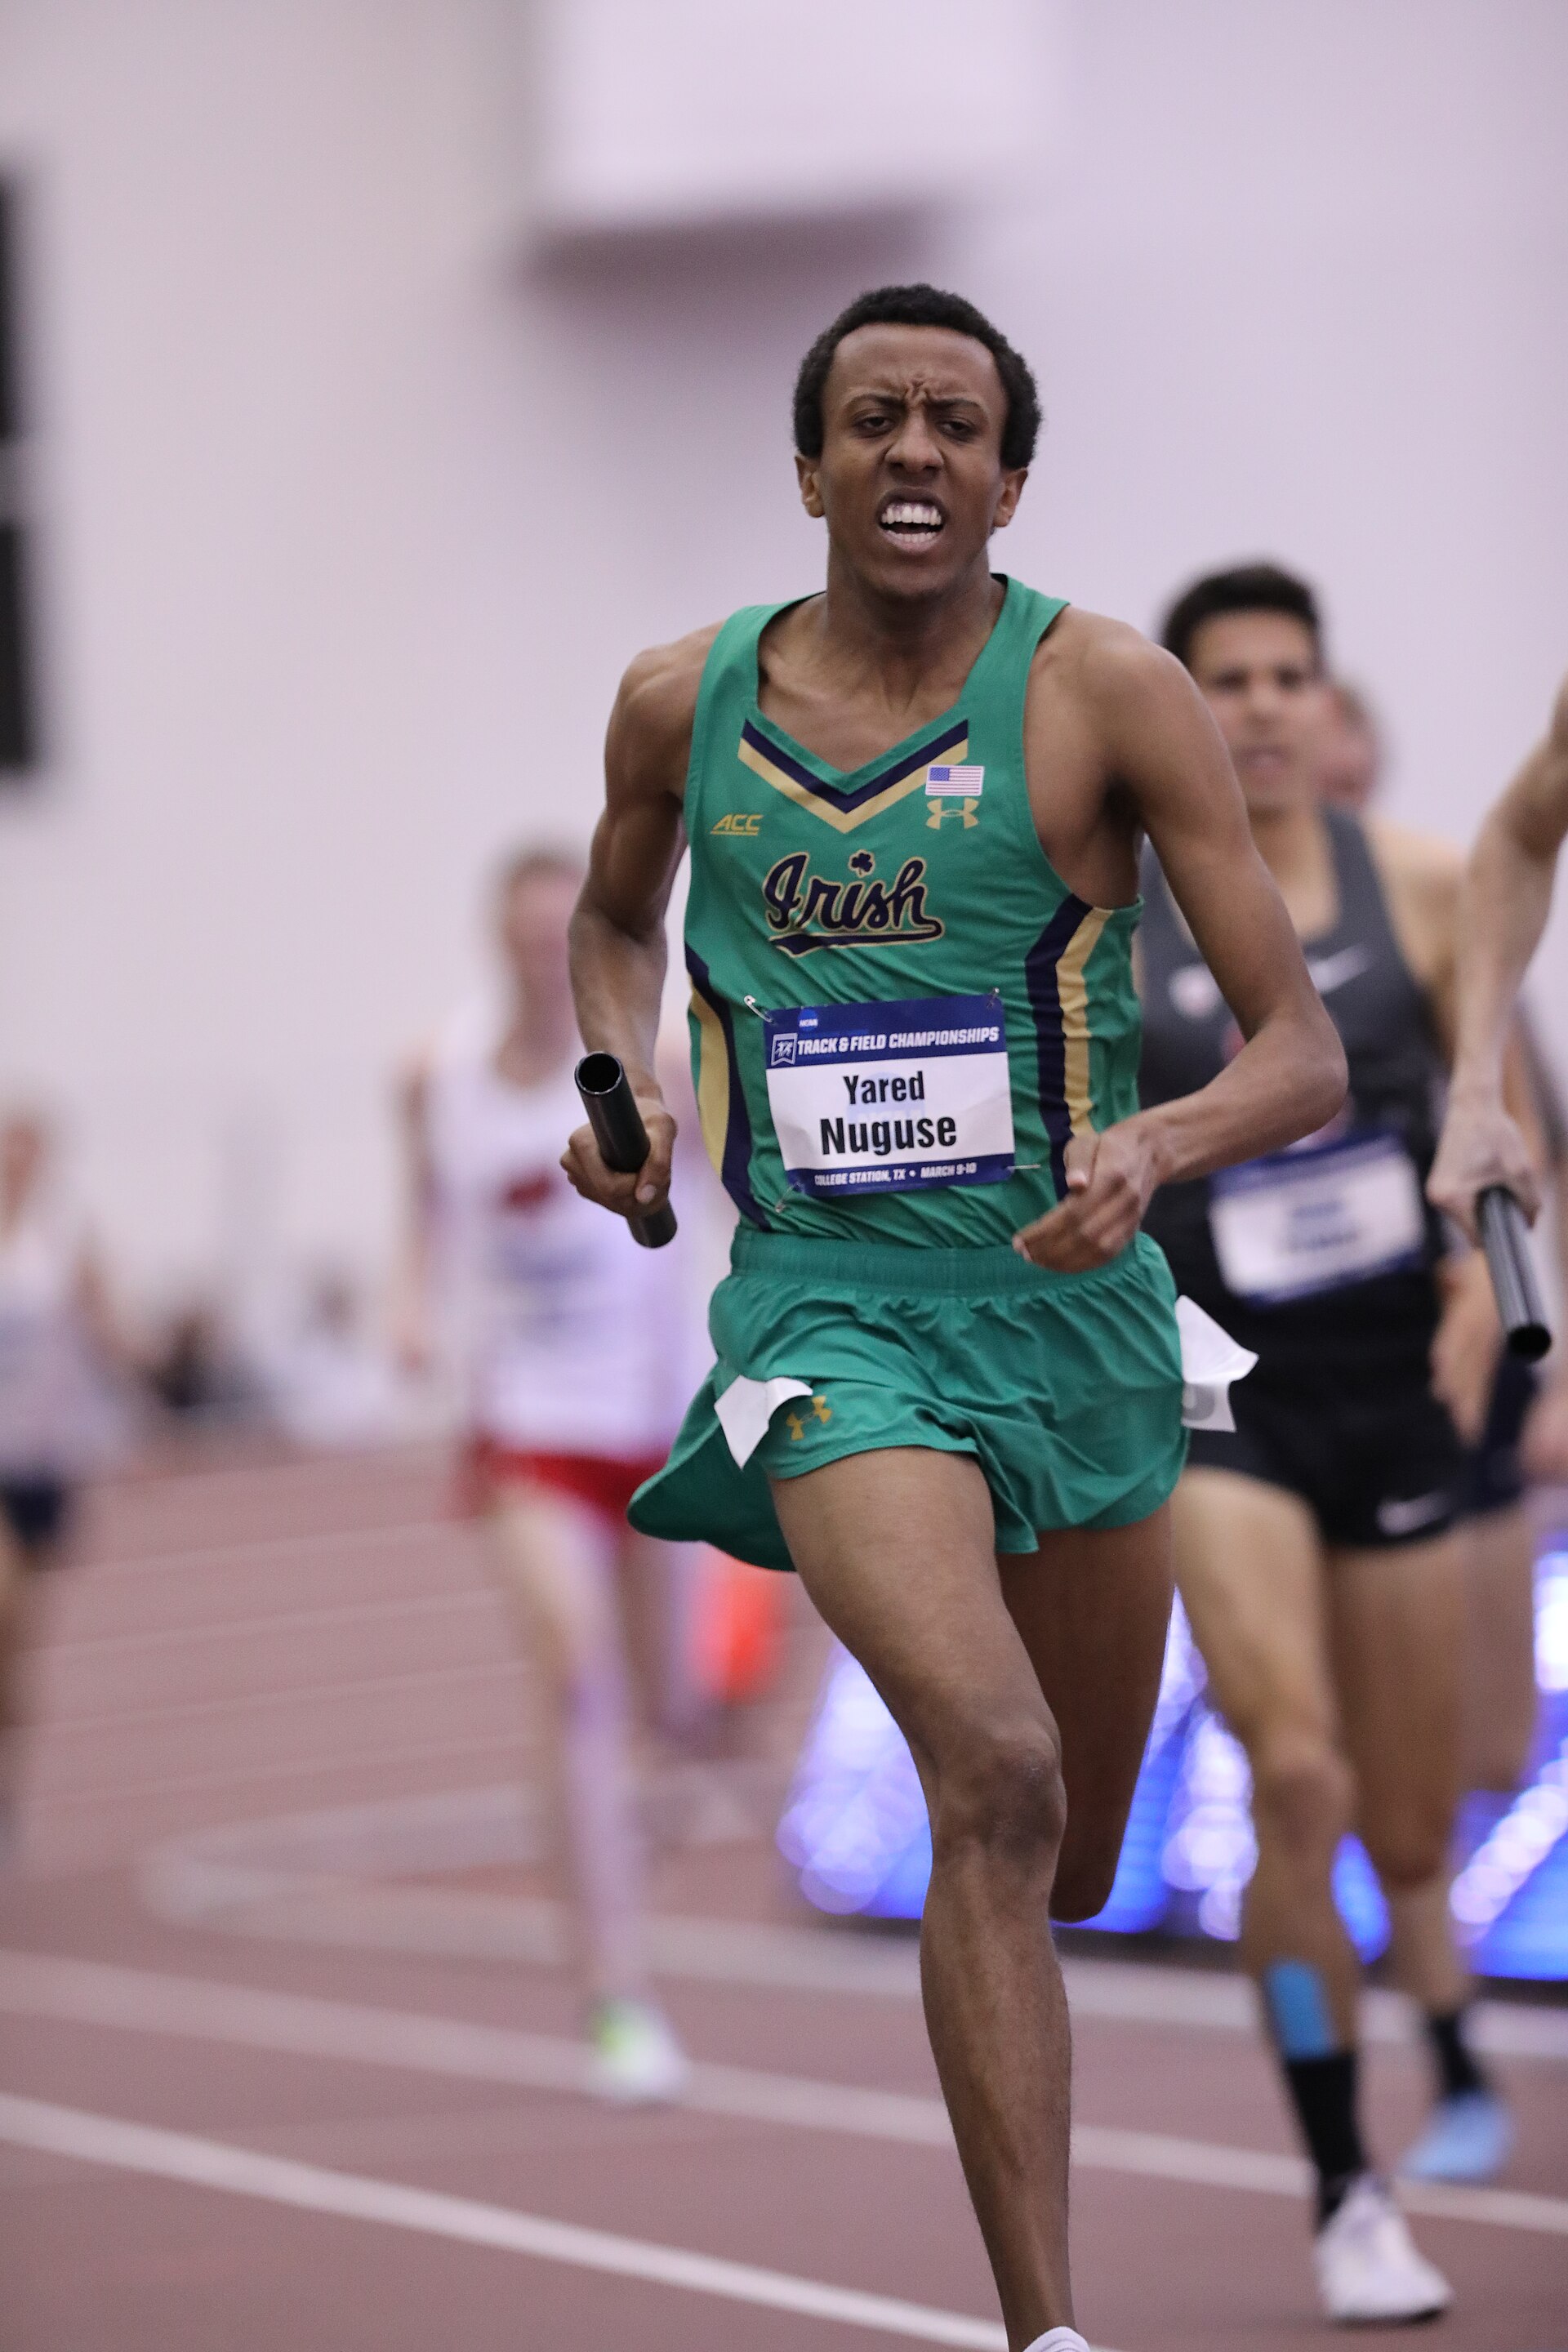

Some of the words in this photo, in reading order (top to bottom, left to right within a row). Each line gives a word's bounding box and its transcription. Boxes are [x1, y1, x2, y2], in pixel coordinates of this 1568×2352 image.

[712, 814, 764, 832] ACC
[763, 851, 945, 951] Irish
[797, 1038, 837, 1055] TRACK
[839, 1039, 850, 1052] &
[850, 1035, 886, 1052] FIELD
[889, 1027, 1000, 1049] CHAMPIONSHIPS
[844, 1071, 925, 1104] Yared
[820, 1116, 957, 1156] Nuguse
[815, 1173, 848, 1186] COLLEGE
[849, 1169, 891, 1183] STATION,
[893, 1169, 906, 1181] TX
[920, 1165, 956, 1178] MARCH
